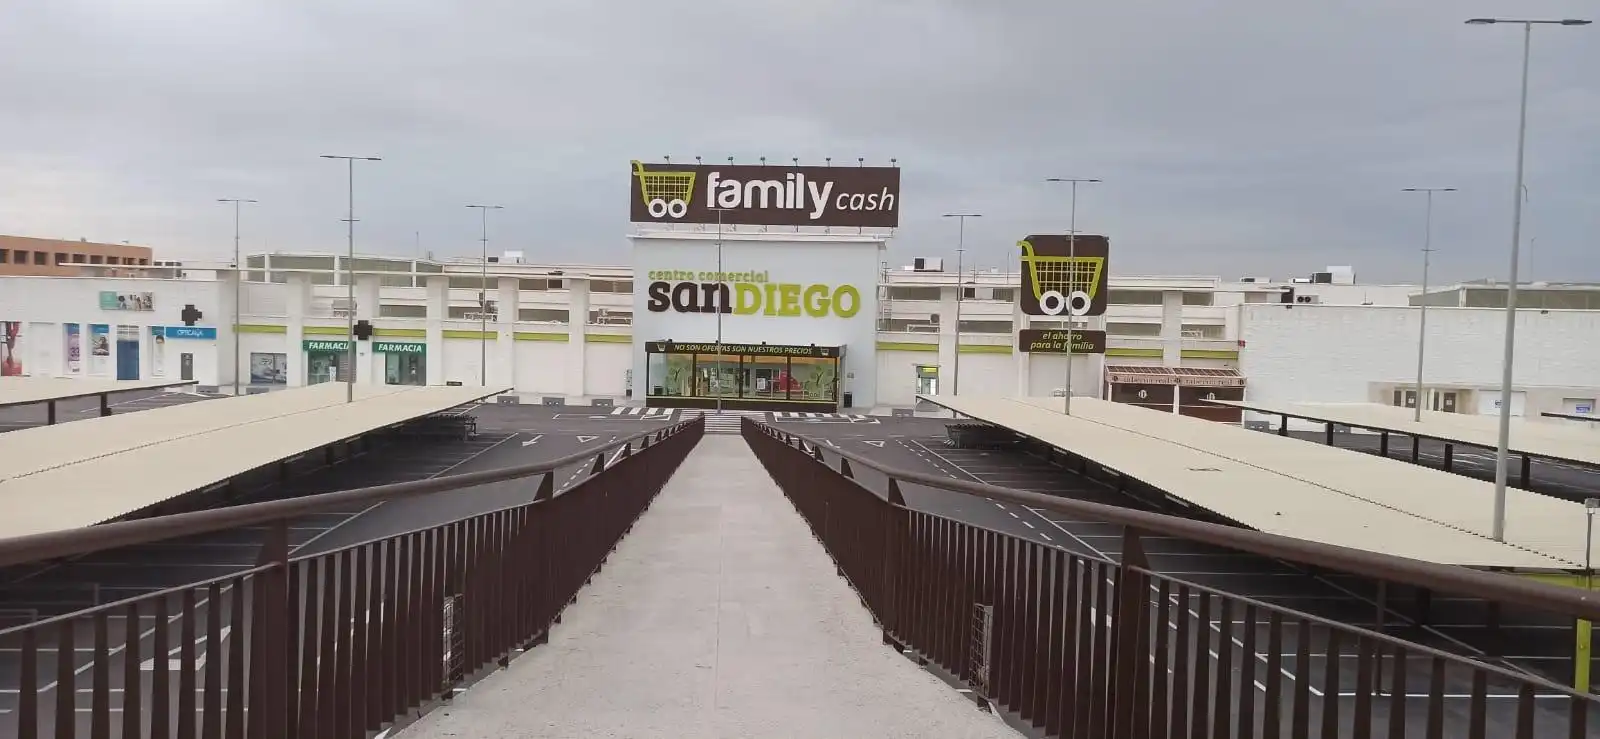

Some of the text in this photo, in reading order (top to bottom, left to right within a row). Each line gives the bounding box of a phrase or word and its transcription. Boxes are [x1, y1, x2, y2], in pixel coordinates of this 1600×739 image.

[706, 171, 895, 220] family cash
[648, 270, 769, 283] centro comercial
[1042, 331, 1051, 340] el
[378, 343, 422, 352] FARMACIA
[686, 344, 701, 352] SON
[732, 345, 746, 353] SON
[747, 346, 783, 354] NUESTROS
[784, 347, 813, 355] PRECIOS
[1030, 340, 1095, 351] para la fmilia
